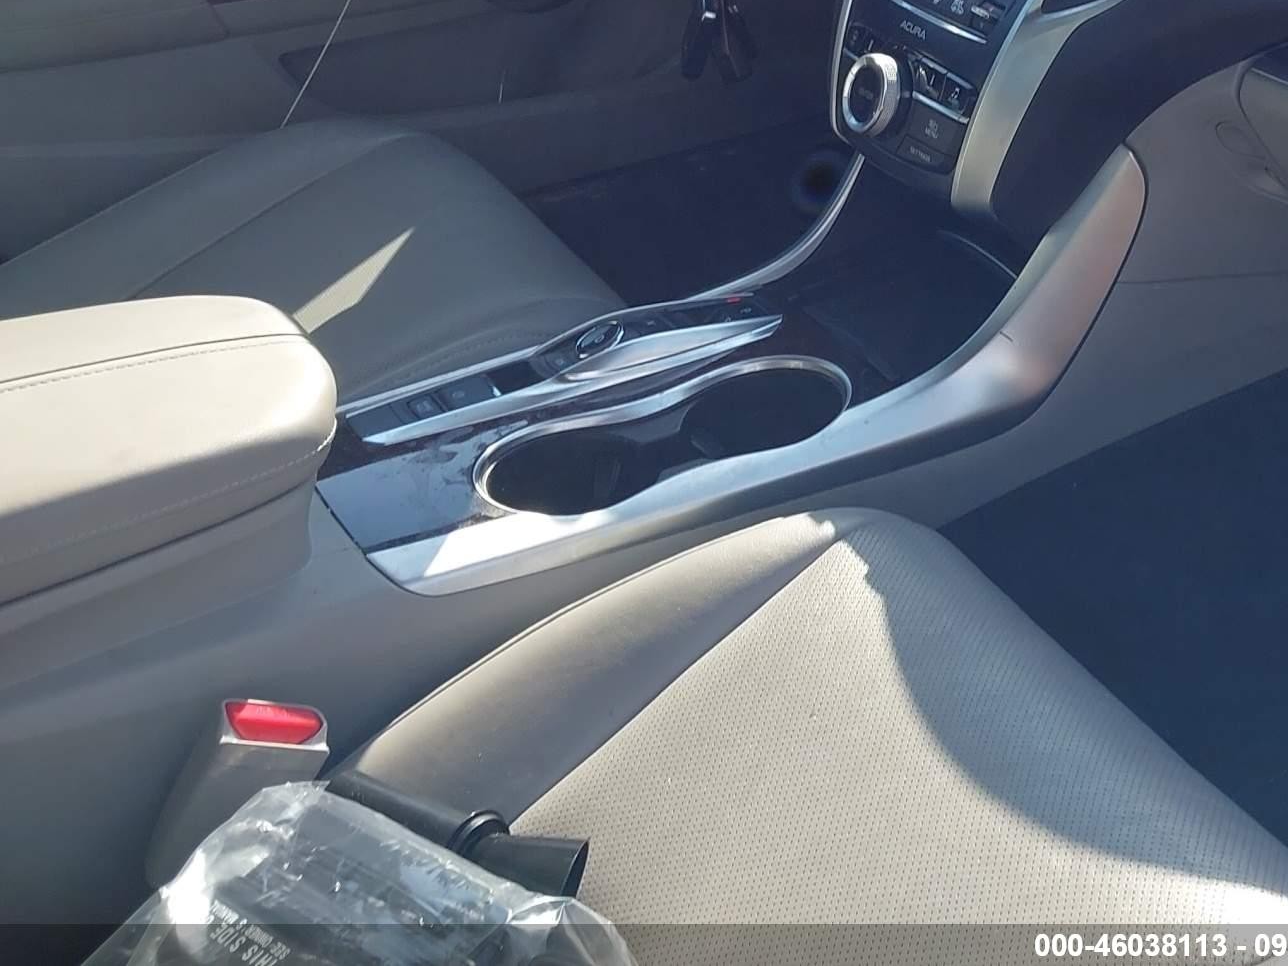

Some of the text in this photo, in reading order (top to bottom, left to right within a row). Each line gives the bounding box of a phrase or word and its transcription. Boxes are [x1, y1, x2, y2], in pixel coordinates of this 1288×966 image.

[900, 19, 927, 41] ACURA
[209, 922, 247, 954] SIDE
[269, 941, 291, 960] SEE
